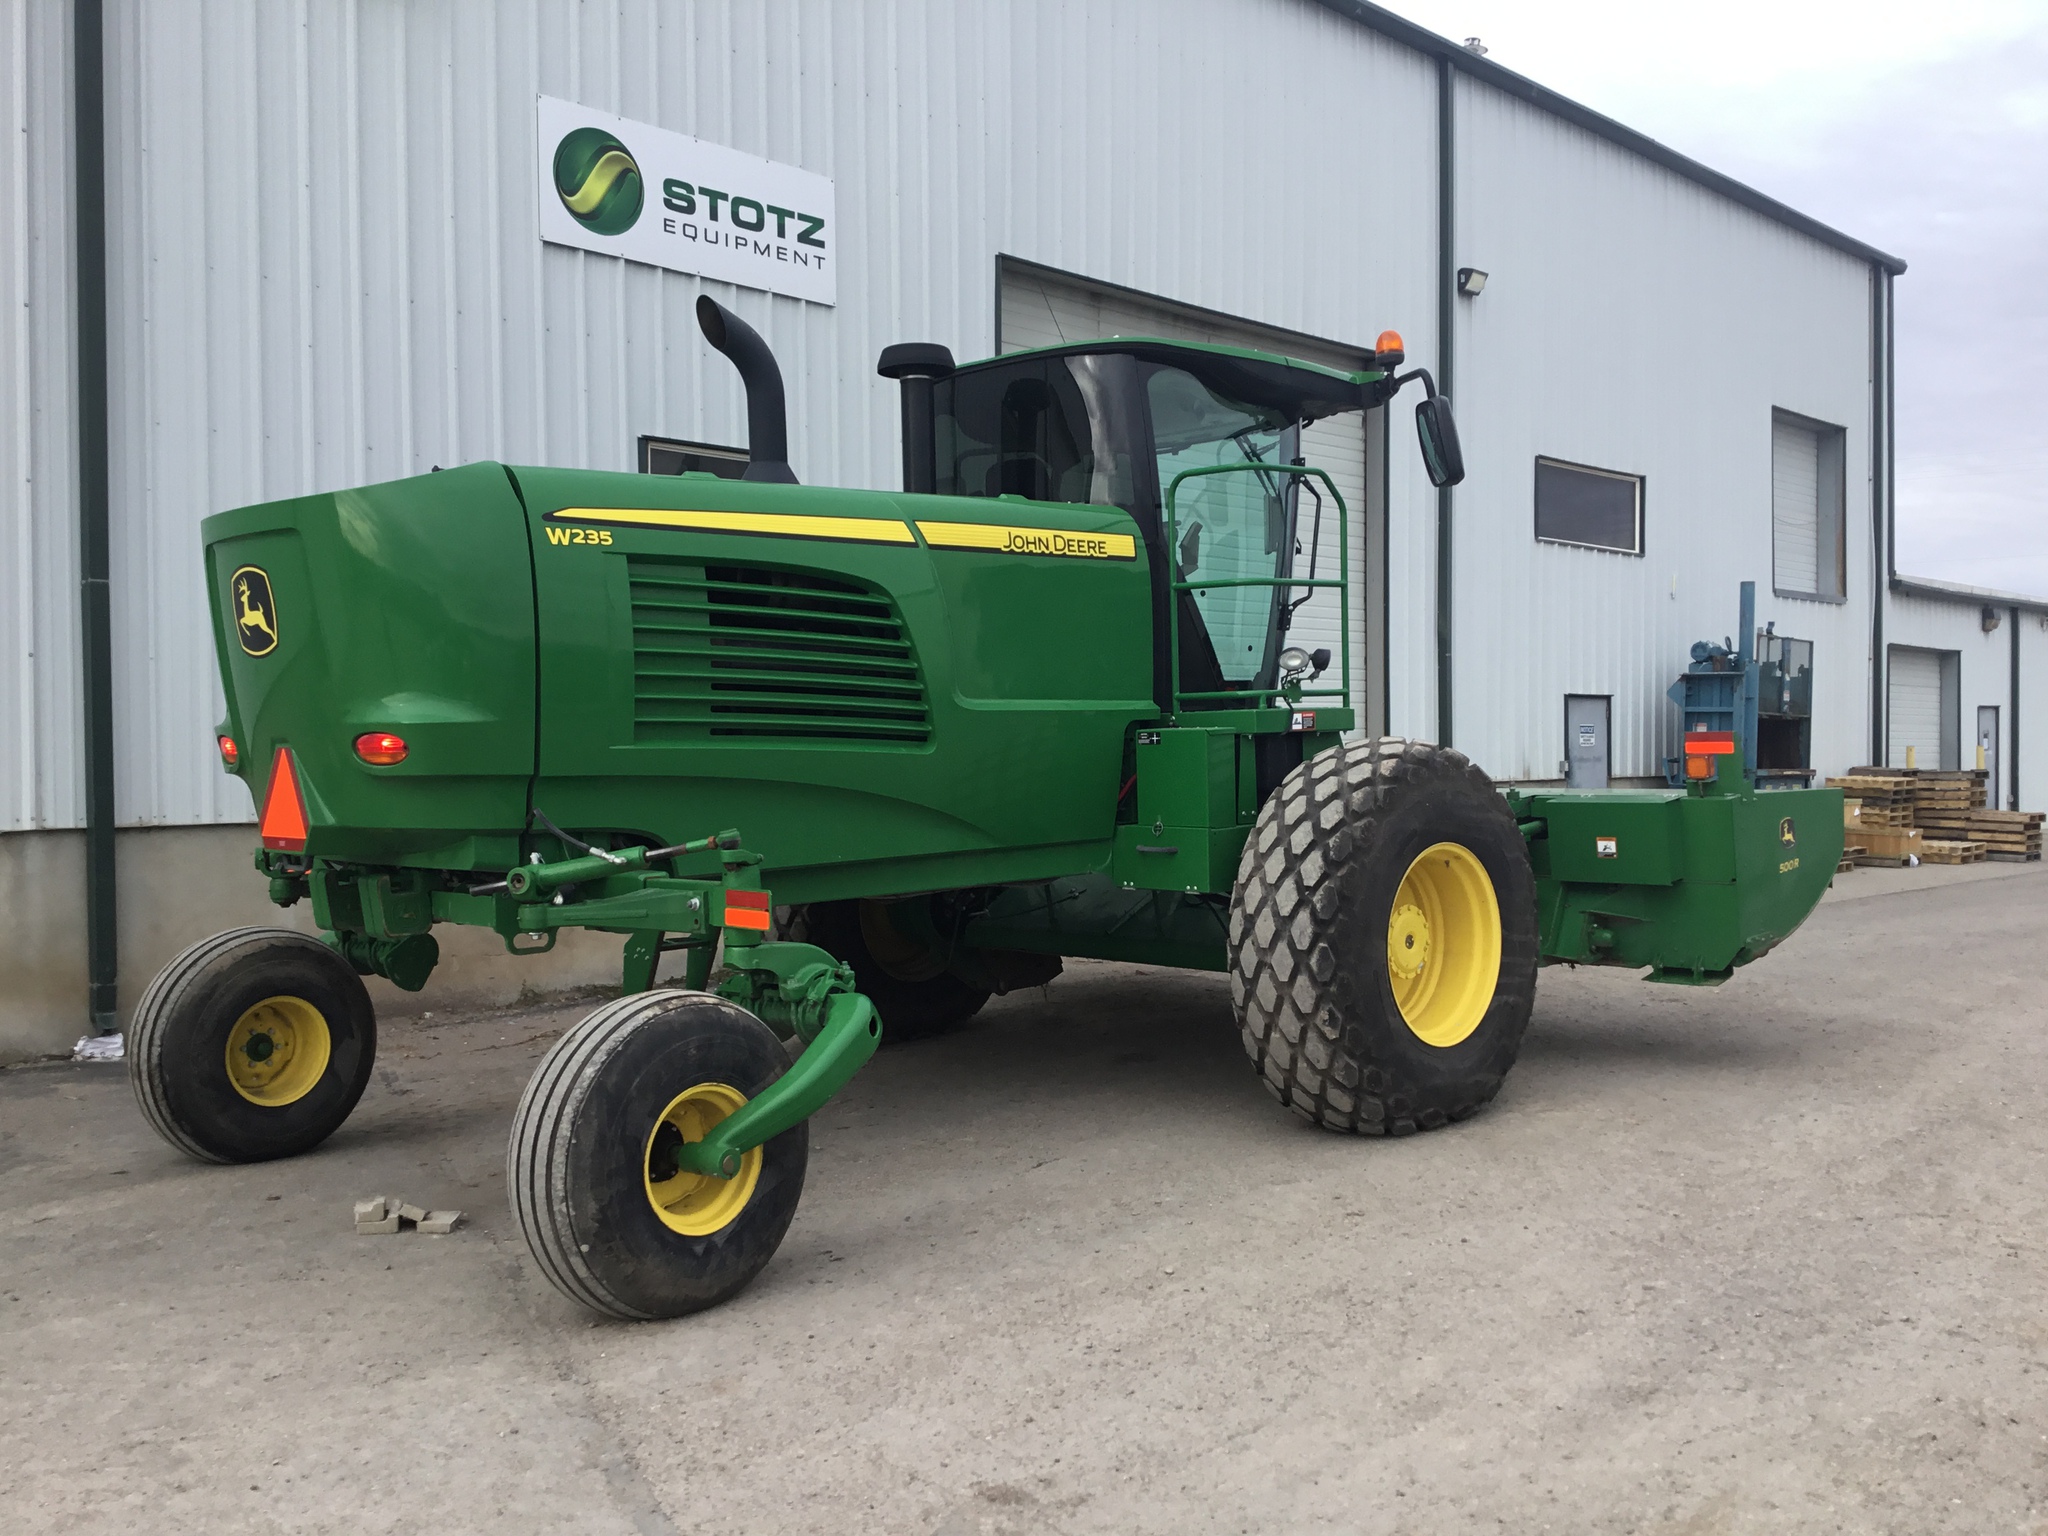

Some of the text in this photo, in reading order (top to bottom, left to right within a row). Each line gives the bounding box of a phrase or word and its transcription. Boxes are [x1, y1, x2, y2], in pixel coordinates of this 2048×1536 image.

[663, 178, 826, 249] STOTZ
[663, 218, 826, 270] EQUIPMENT
[544, 527, 614, 546] W235
[1002, 531, 1108, 555] JOHN DEERE
[1779, 858, 1800, 874] 500R
